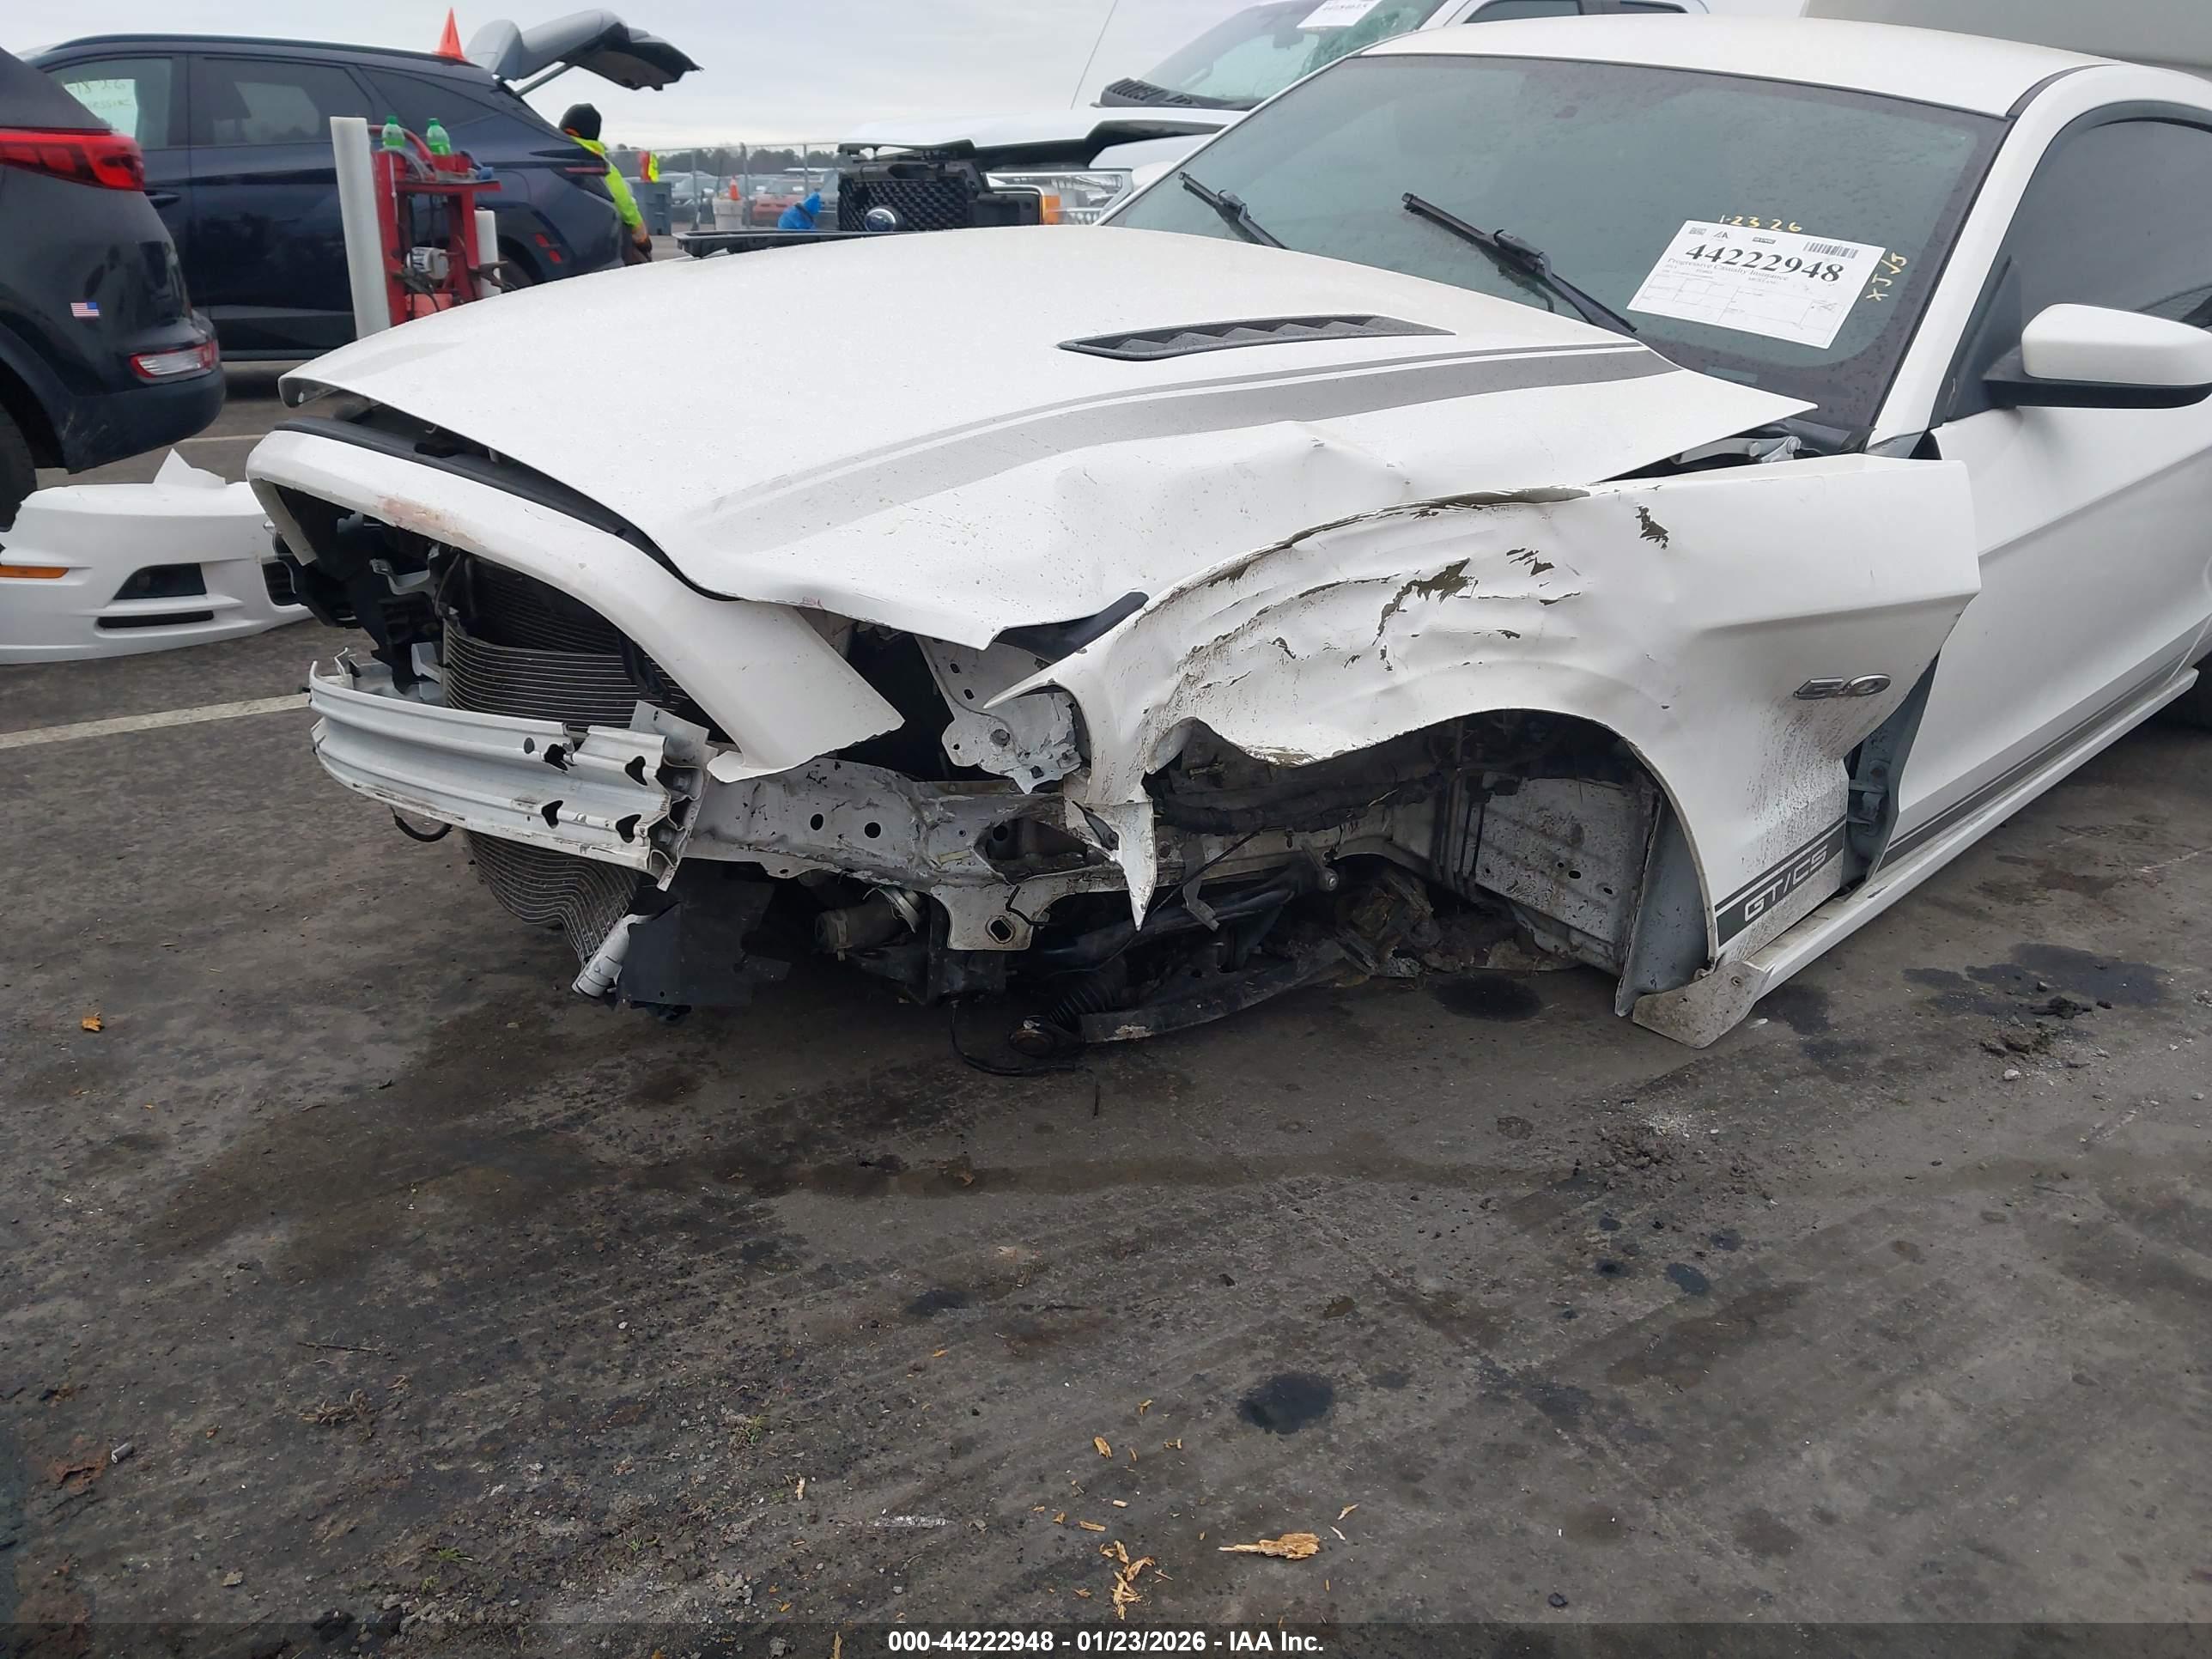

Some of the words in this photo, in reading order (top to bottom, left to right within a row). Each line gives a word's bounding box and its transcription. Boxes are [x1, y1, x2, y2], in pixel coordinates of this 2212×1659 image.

[1668, 258, 1712, 270] Progressive
[1714, 264, 1747, 275] Casualty
[1749, 269, 1790, 282] Insurance
[1686, 244, 1844, 282] 44222948
[1744, 844, 1828, 922] GT/CS
